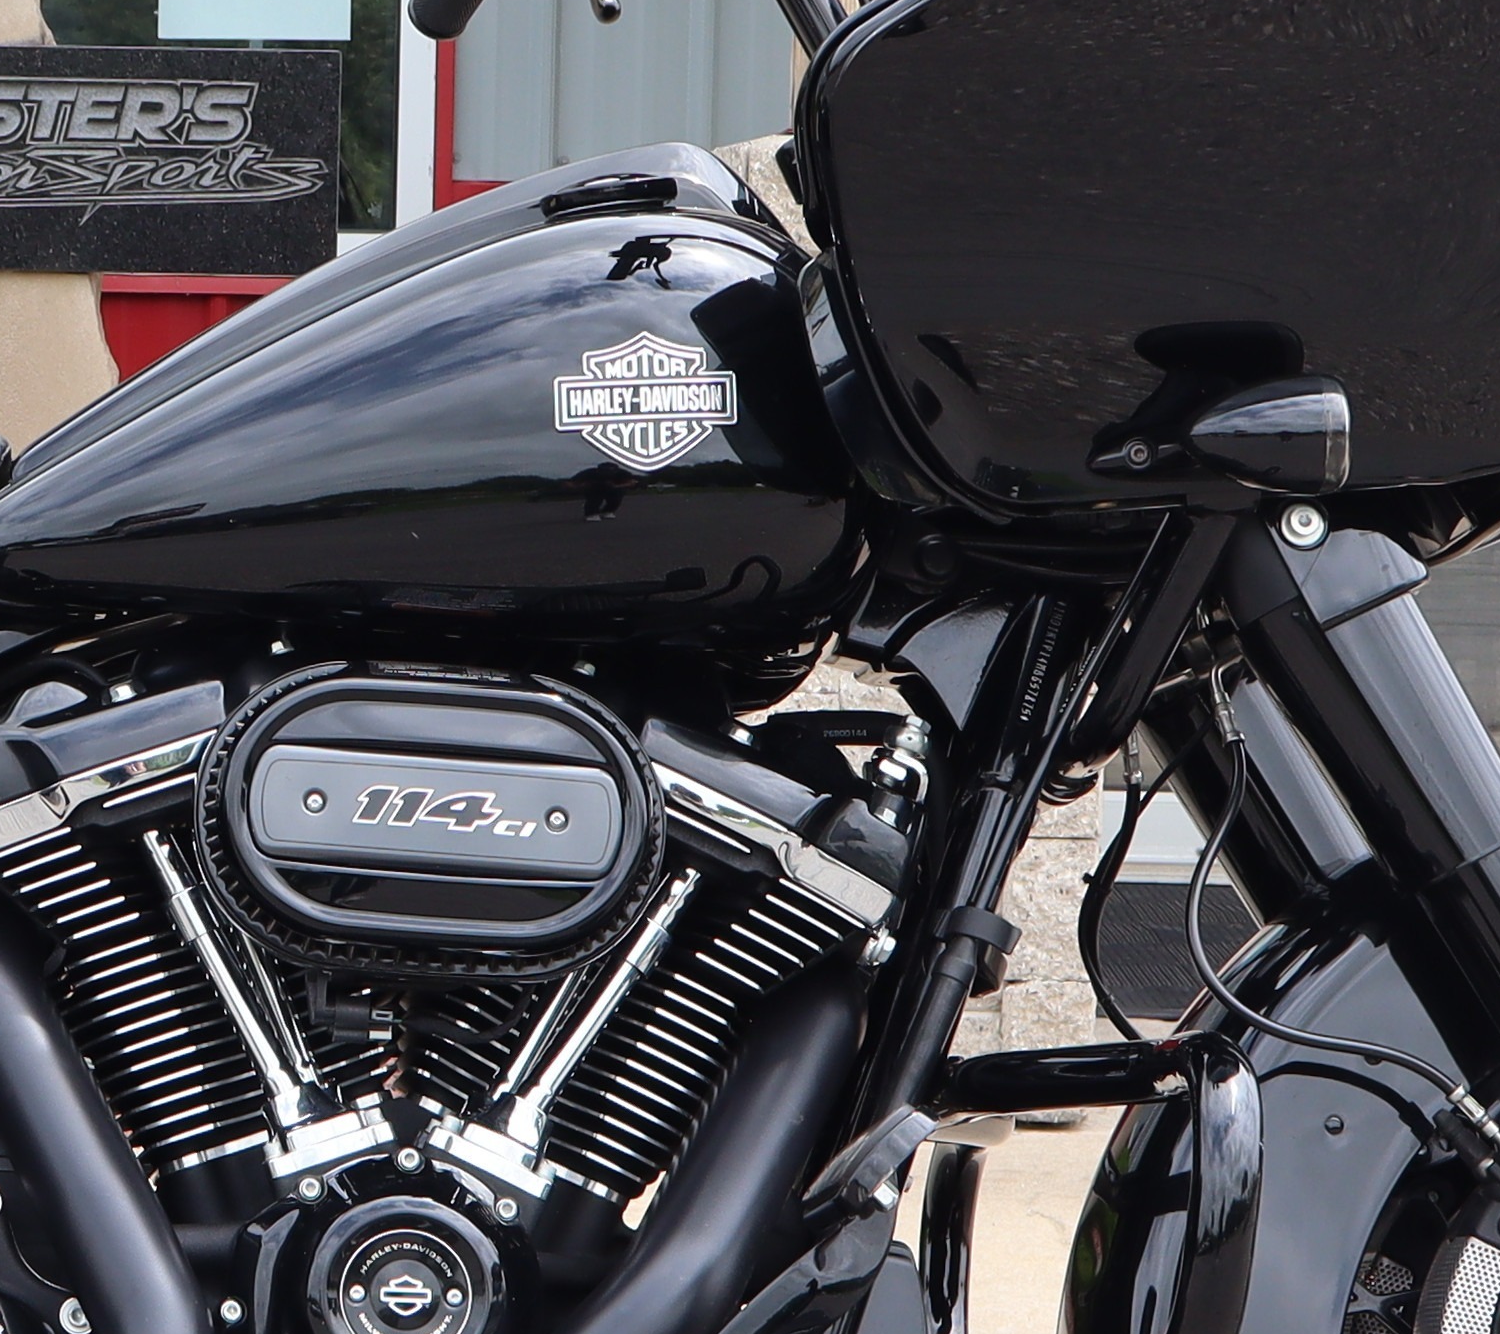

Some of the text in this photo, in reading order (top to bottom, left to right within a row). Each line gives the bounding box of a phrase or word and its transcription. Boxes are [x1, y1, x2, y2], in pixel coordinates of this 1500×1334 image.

[605, 347, 686, 379] MOTOR
[569, 384, 722, 417] HARLEY-DAVIDSON
[605, 421, 689, 456] CYCLES
[359, 1241, 453, 1279] HARLEY-DAVIDSON
